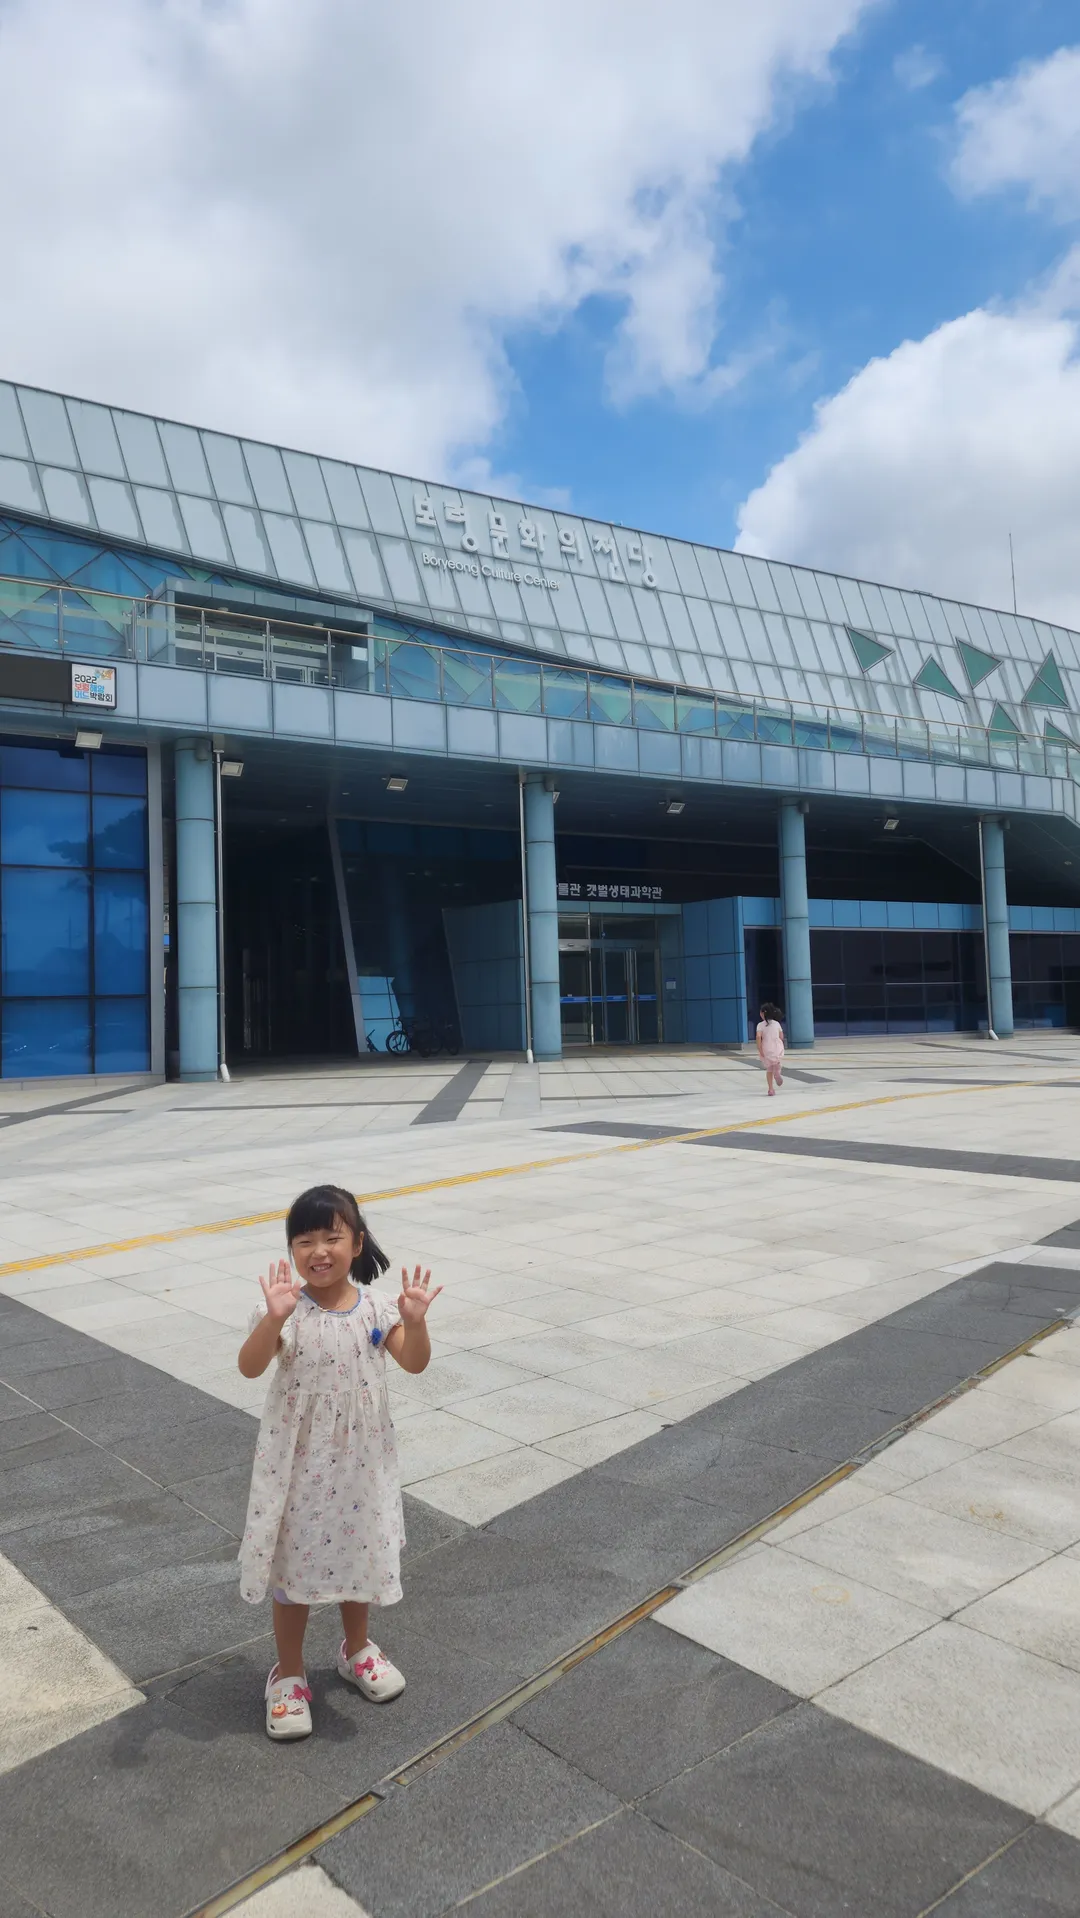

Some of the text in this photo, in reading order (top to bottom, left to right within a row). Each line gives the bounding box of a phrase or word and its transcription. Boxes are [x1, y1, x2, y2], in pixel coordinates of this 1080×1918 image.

[422, 552, 560, 590] Boryeong Culture Center
[74, 674, 97, 684] 2022
[556, 883, 662, 899] 물관 갯벌생태과학관
